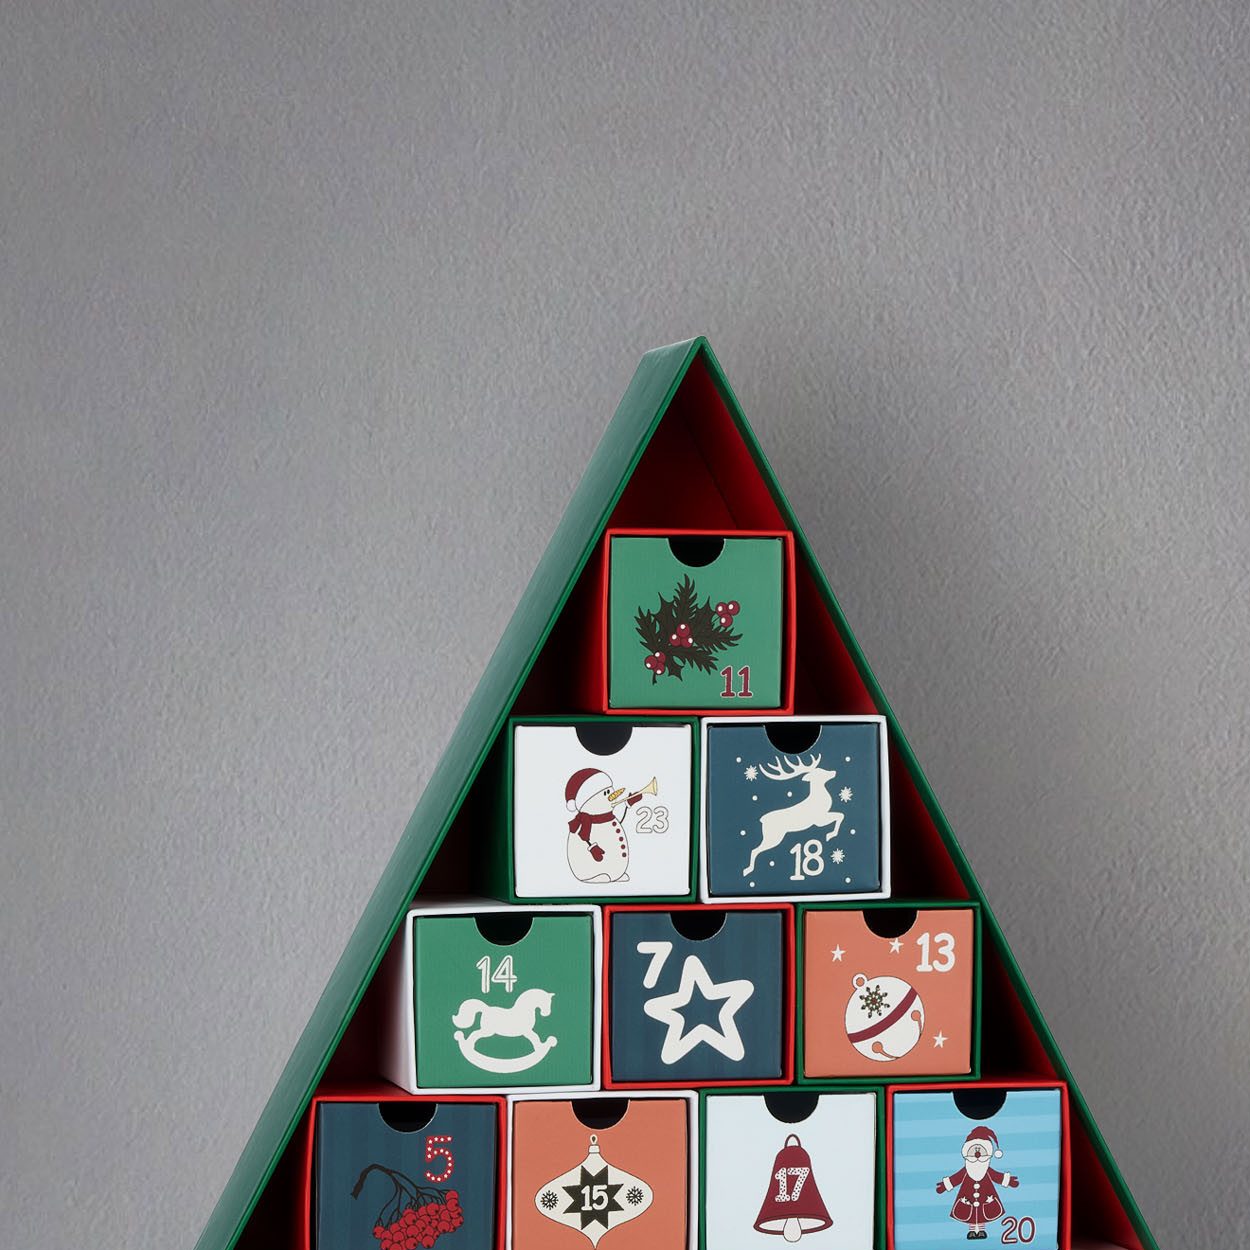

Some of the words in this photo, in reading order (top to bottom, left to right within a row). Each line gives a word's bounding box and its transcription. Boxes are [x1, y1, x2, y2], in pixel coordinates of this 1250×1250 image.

[719, 666, 753, 698] 11
[635, 806, 670, 835] 23
[789, 839, 825, 881] 18
[636, 941, 673, 989] 7
[916, 932, 956, 973] 13
[475, 955, 518, 993] 14
[424, 1135, 454, 1183] 5
[580, 1184, 609, 1212] 15
[774, 1167, 810, 1202] 17
[1000, 1216, 1036, 1244] 20
